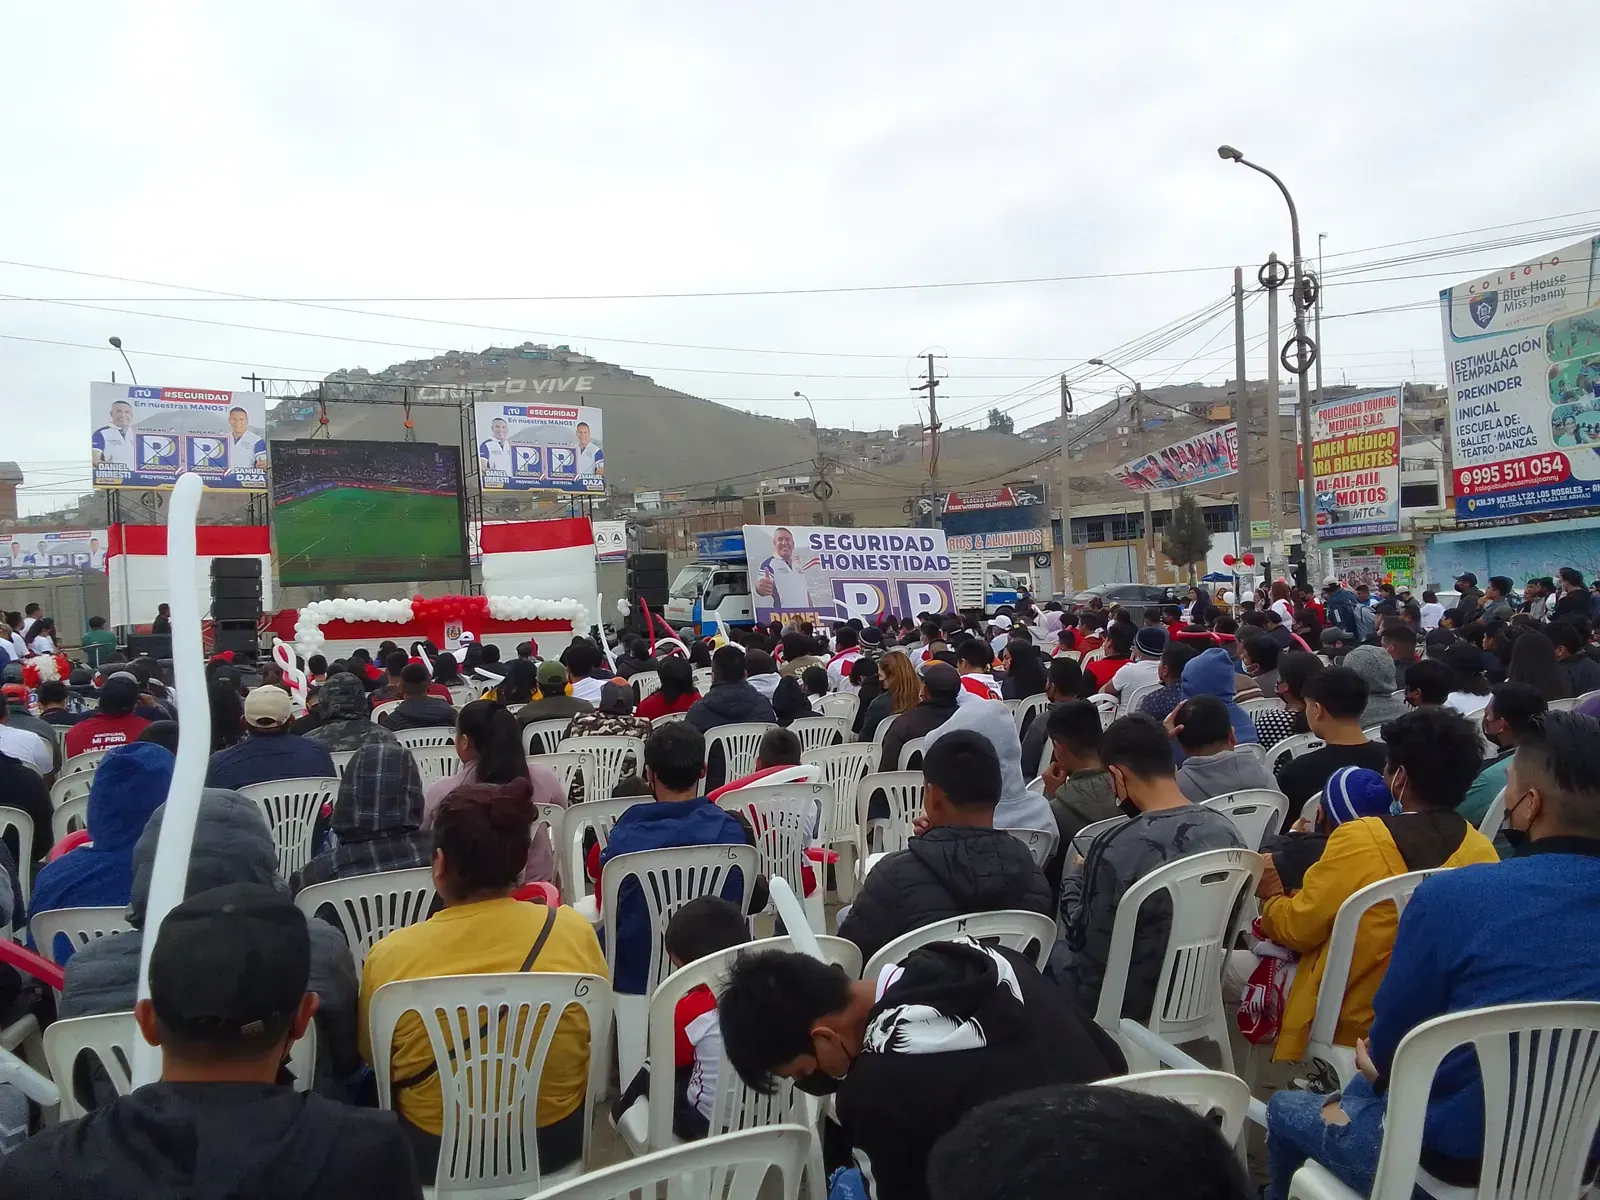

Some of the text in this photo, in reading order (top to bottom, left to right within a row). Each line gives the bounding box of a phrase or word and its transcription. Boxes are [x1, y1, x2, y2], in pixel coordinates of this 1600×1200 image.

[1469, 257, 1559, 294] COLEGIO
[1503, 274, 1566, 301] Blue House
[1503, 287, 1567, 313] Miss Joanny
[1455, 336, 1541, 371] ESTIMULACIÓN
[1455, 357, 1518, 383] TEMPRANA
[532, 376, 595, 394] VIVE
[1457, 375, 1522, 402] PREKINDER
[164, 390, 229, 401] #SEGURIDAD
[148, 401, 188, 410] nuestras
[529, 409, 577, 417] #SEGURIDAD
[1318, 394, 1396, 420] POLICLINICO TOURING
[1459, 400, 1500, 420] INICIAL
[1329, 417, 1362, 432] MEDICAL
[1460, 413, 1520, 436] ESCUELA DE:
[1301, 431, 1396, 460] AMEN MÉDICO
[1461, 424, 1534, 448] BALLET MÚSICA
[1462, 436, 1538, 458] TEATRO DANZAS
[98, 463, 129, 471] DANIEL
[234, 467, 265, 475] SAMUEL
[1313, 449, 1393, 475] ARA BREVETES
[1472, 455, 1563, 485] 995 511 054
[96, 470, 132, 479] URRESTI
[236, 474, 265, 482] DAZA
[1336, 487, 1388, 506] MOTOS
[1537, 489, 1550, 498] LOS
[1551, 485, 1583, 497] ROSALES
[1353, 507, 1375, 519] MTC
[809, 533, 935, 552] SEGURIDAD
[948, 537, 973, 550] RIOS
[975, 535, 984, 548] &
[985, 529, 1042, 548] ALUMINIOS
[819, 553, 951, 572] HONESTIDAD
[1386, 562, 1410, 570] CHACAS
